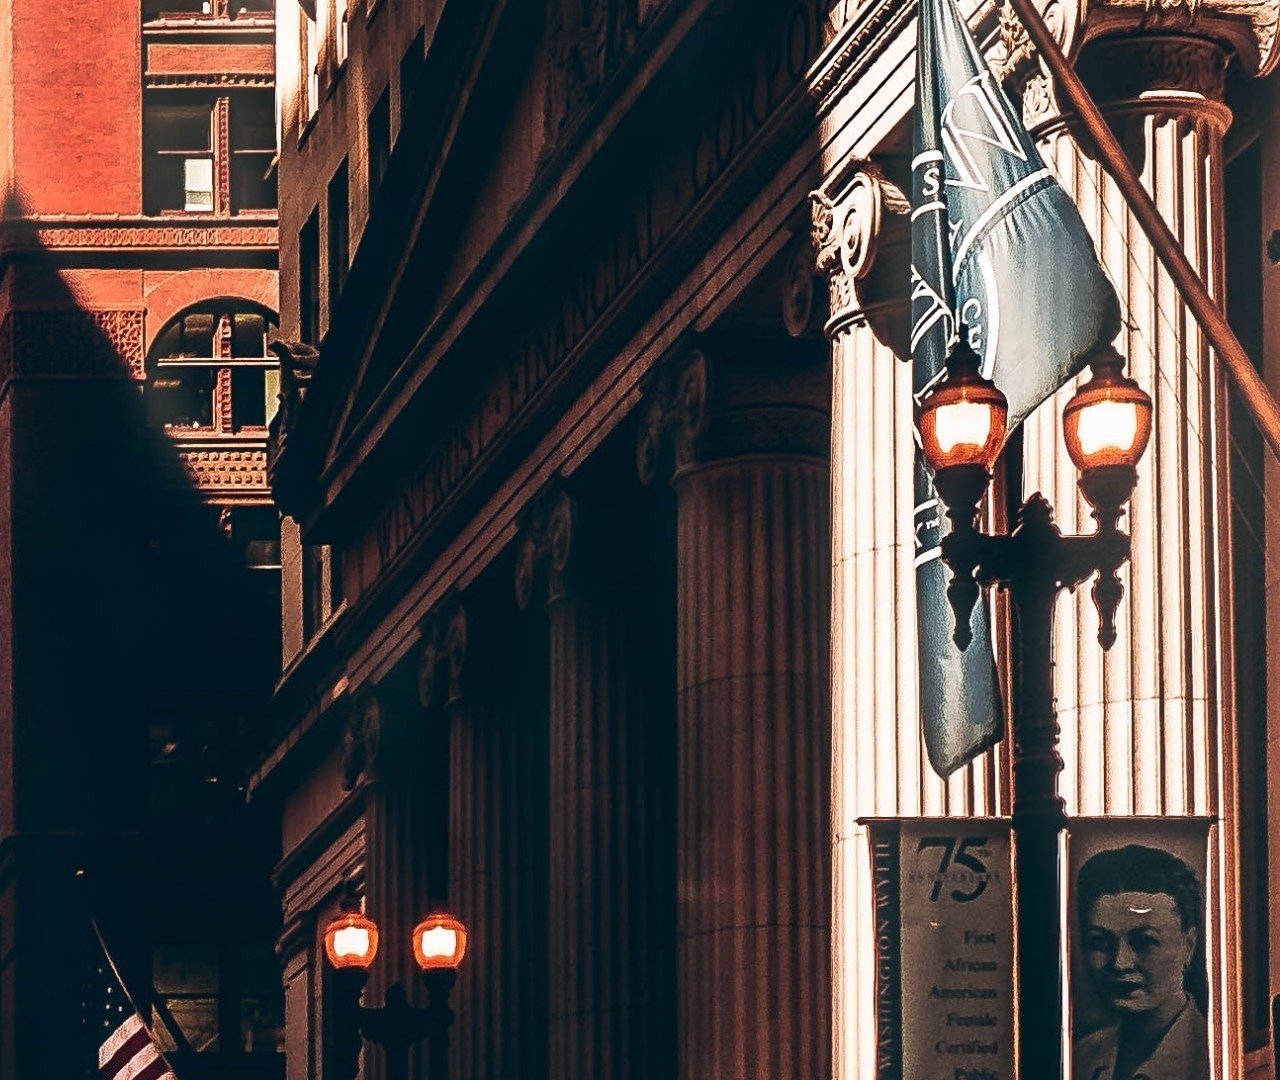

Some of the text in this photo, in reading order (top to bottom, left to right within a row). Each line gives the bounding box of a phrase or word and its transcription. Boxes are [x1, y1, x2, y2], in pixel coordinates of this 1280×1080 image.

[373, 395, 483, 580] WINTRUST
[507, 189, 651, 421] FINANCIAL
[917, 837, 989, 902] 75
[963, 930, 997, 944] First
